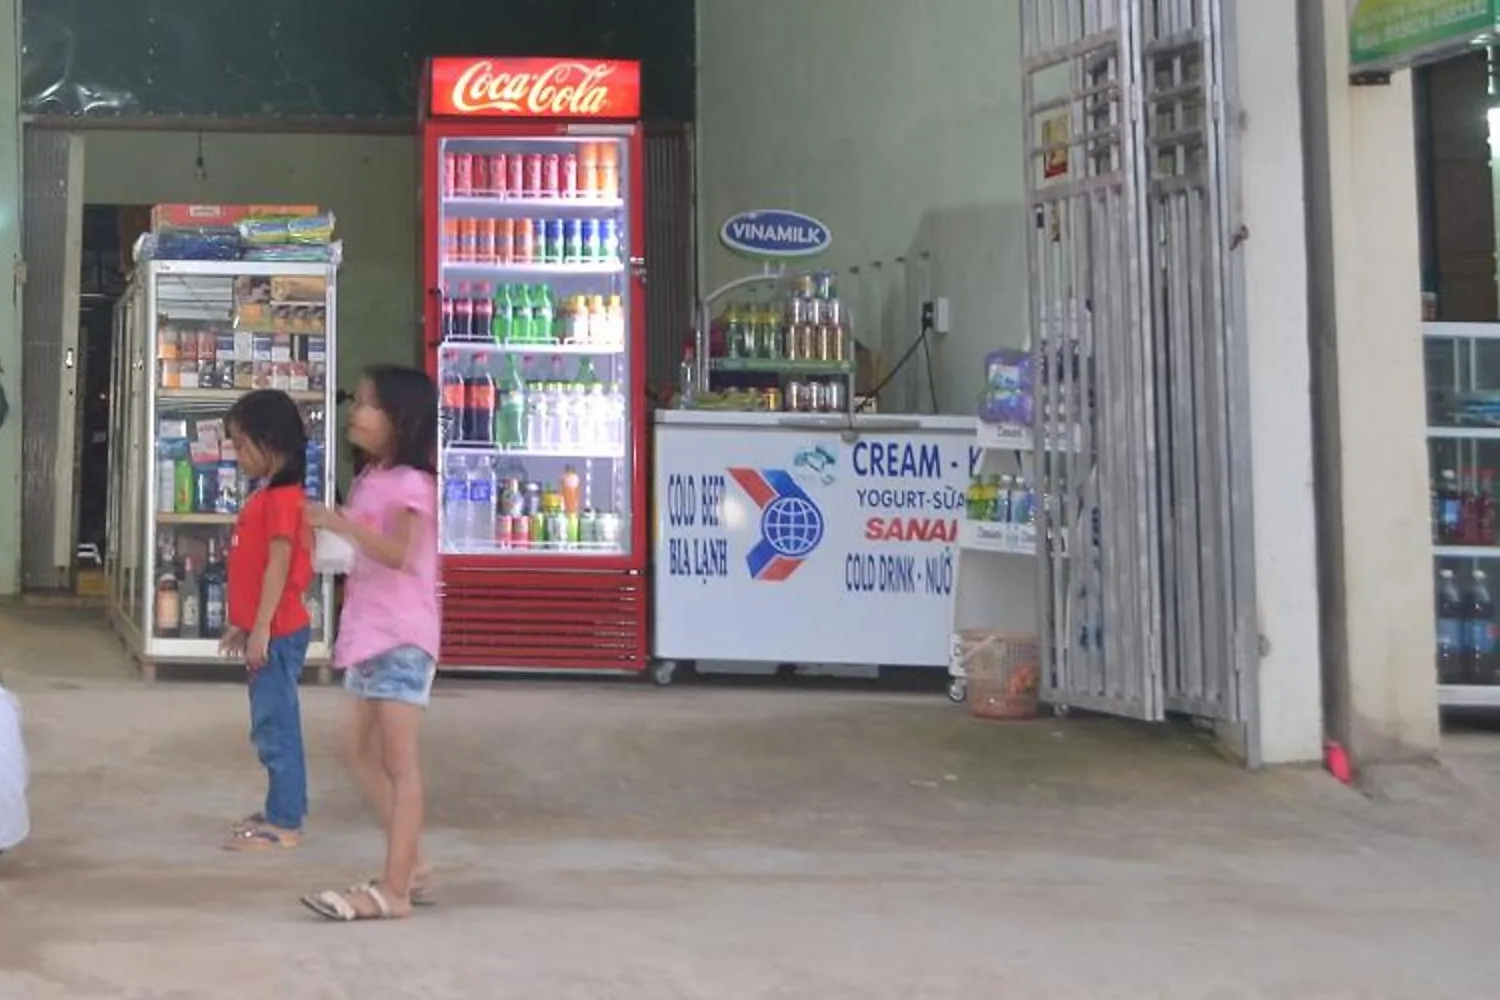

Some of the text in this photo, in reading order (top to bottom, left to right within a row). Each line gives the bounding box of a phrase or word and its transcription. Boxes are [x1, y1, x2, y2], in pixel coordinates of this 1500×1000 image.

[452, 60, 618, 113] Coca-Cola
[732, 223, 822, 243] VINAMILK
[852, 441, 941, 479] CREAM
[667, 473, 696, 527] COLD
[865, 517, 959, 542] SANA
[669, 538, 691, 577] BIA
[845, 552, 875, 592] COLD
[879, 554, 915, 593] DRINK
